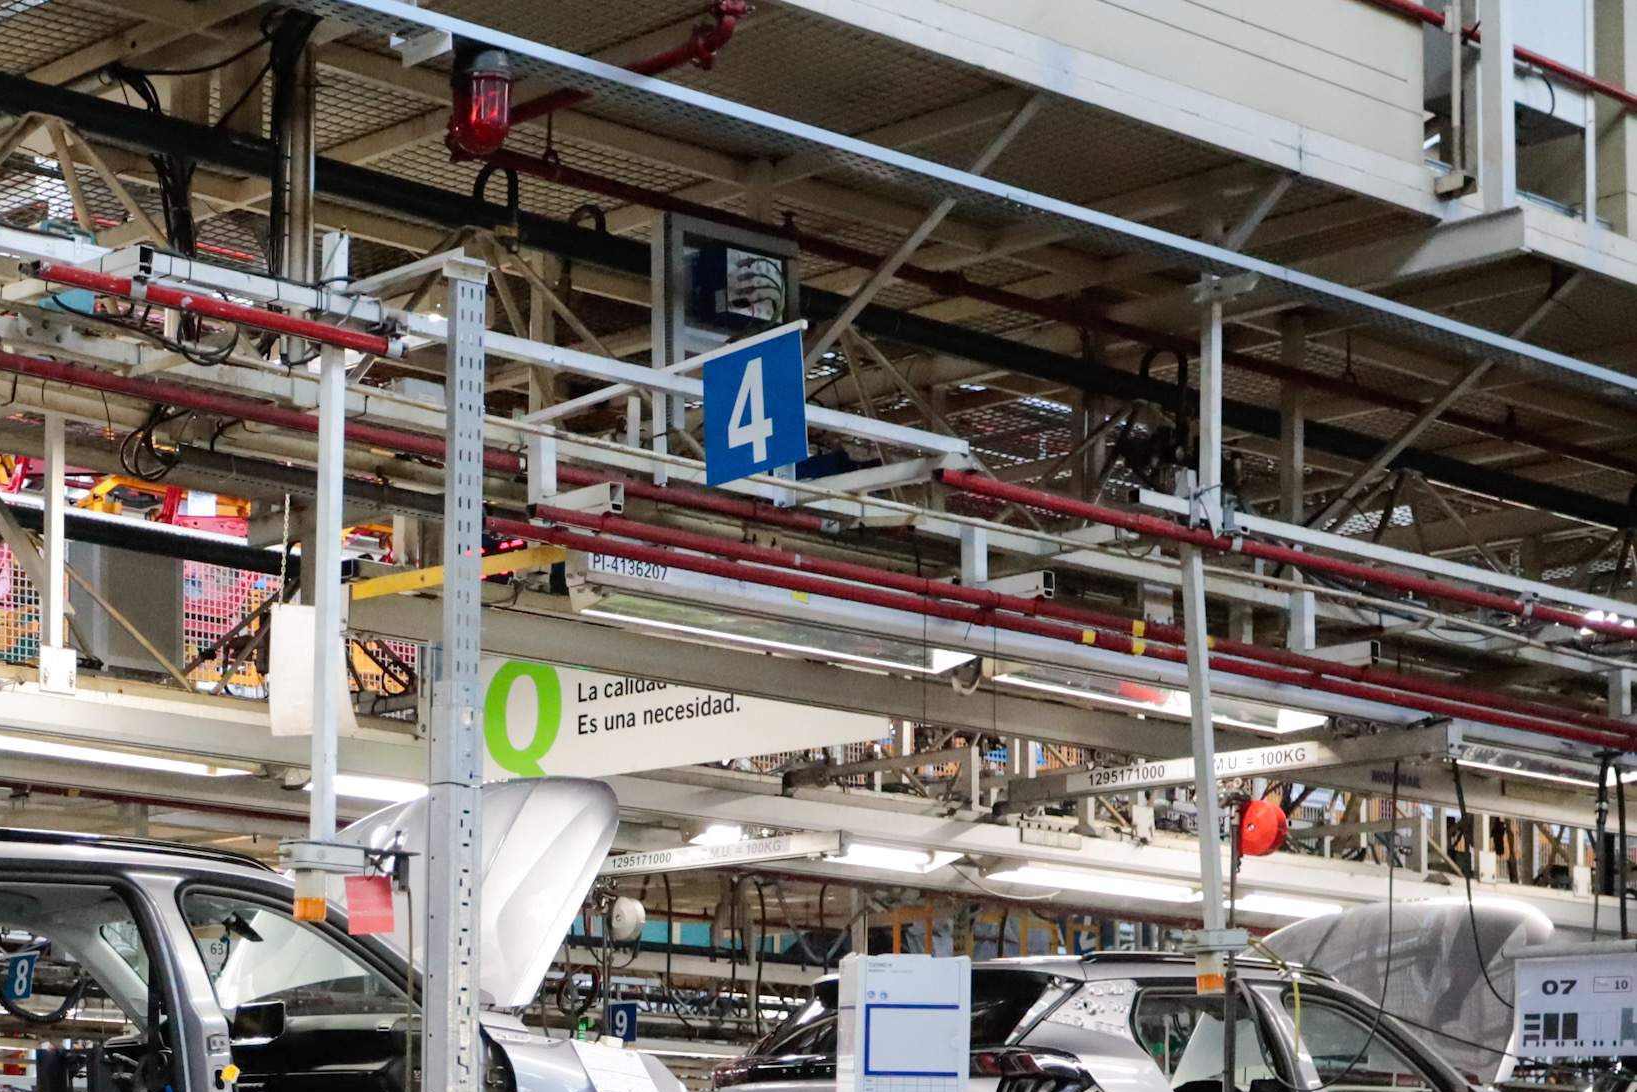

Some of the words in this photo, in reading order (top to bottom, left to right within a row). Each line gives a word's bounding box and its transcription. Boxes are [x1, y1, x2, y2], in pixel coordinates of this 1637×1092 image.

[727, 356, 774, 465] 4
[578, 682, 598, 703] La
[578, 714, 598, 735] Es
[604, 712, 636, 732] una
[643, 693, 741, 726] necesidad.
[1088, 764, 1165, 787] 1295171000
[1260, 748, 1306, 766] 100KG
[612, 852, 672, 869] 1295171000
[13, 958, 29, 997] 8
[1541, 979, 1578, 996] 07
[1614, 980, 1629, 990] 10
[615, 1009, 628, 1038] 9
